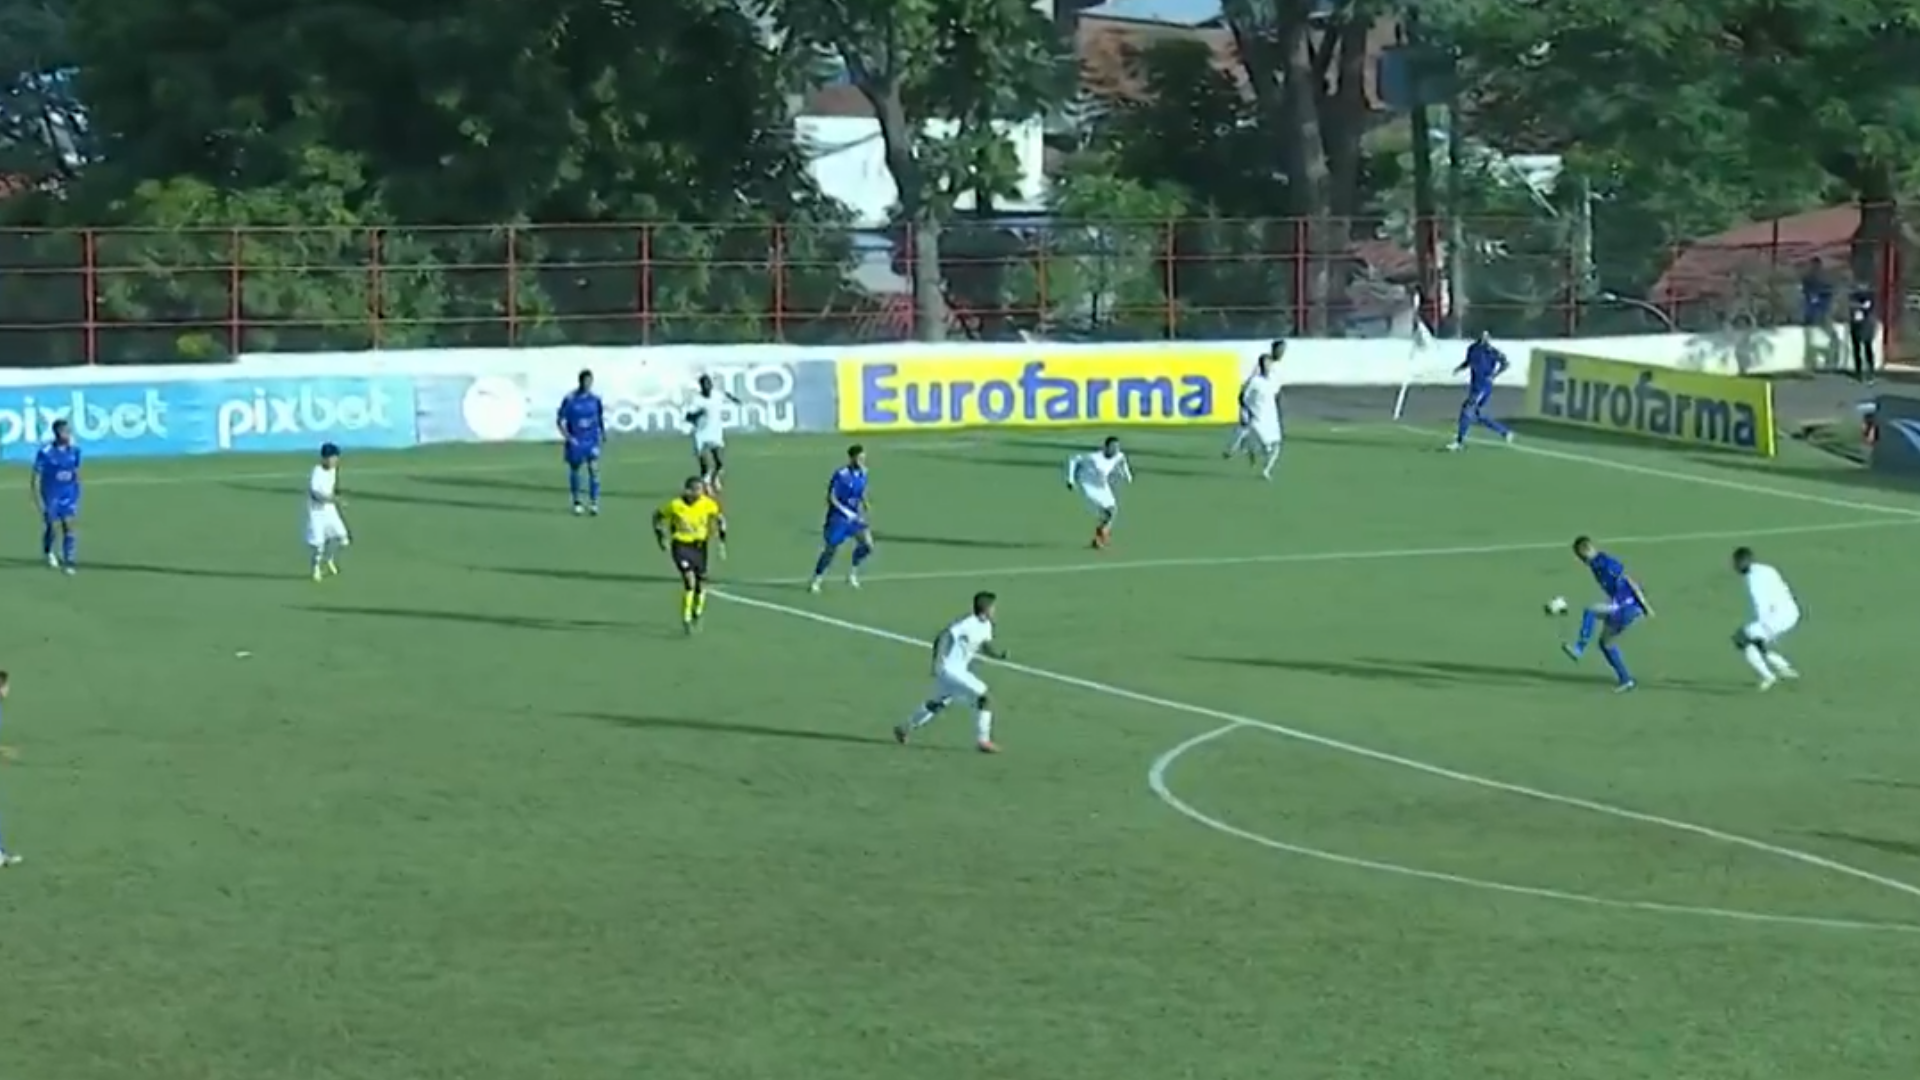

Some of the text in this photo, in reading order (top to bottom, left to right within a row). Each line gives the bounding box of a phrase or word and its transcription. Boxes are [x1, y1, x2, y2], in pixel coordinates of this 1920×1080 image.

[218, 388, 394, 449] pixbet
[861, 361, 1213, 424] Eurofarma
[1541, 356, 1757, 447] Eurofarma
